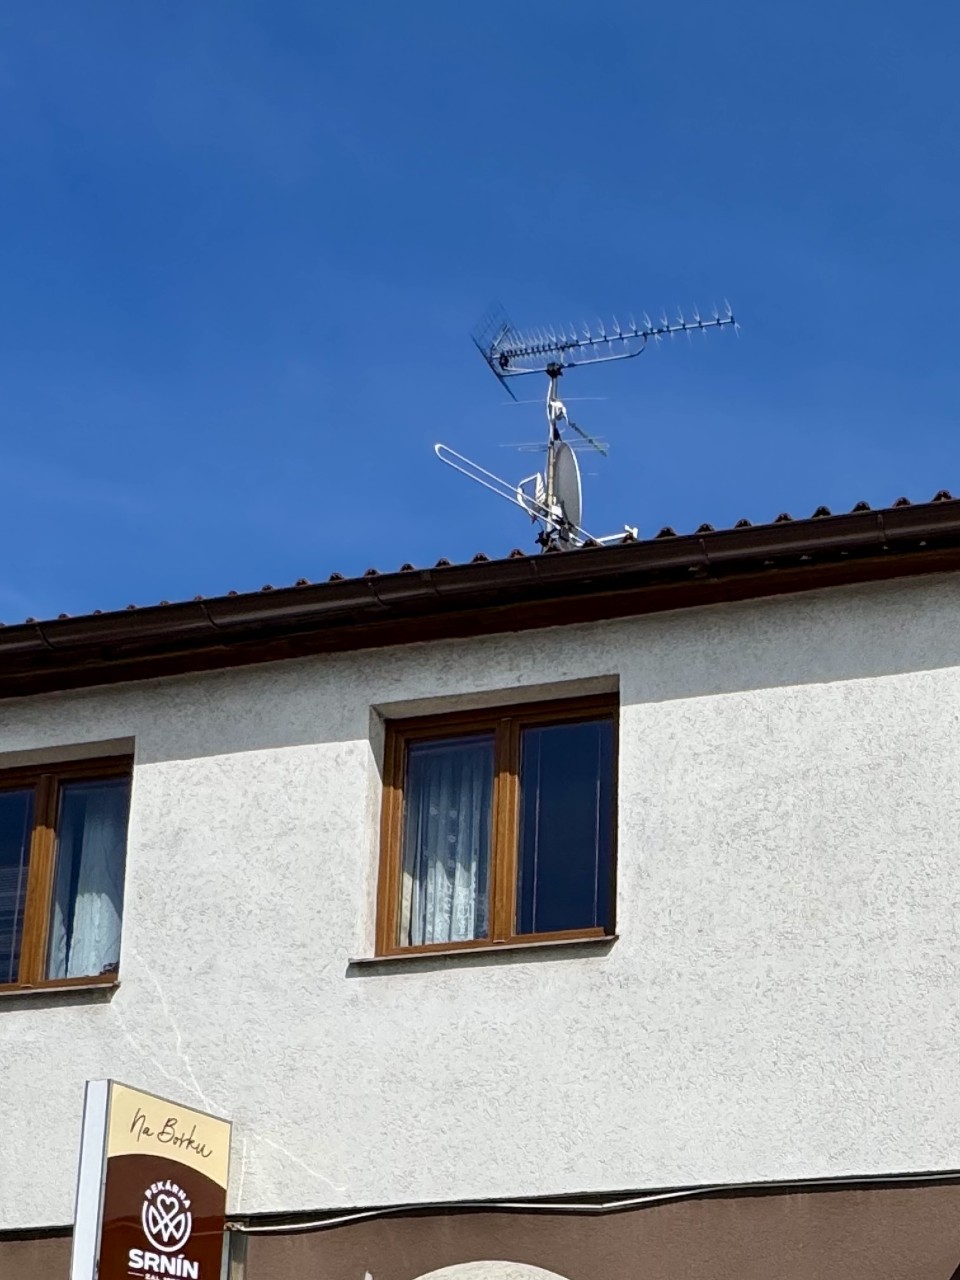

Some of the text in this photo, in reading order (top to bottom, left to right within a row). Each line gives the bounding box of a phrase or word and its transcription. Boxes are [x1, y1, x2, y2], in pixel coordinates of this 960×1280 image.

[130, 1107, 213, 1158] Na Borku
[144, 1179, 191, 1209] PEKÁRNA
[128, 1248, 199, 1280] SRNÍN
